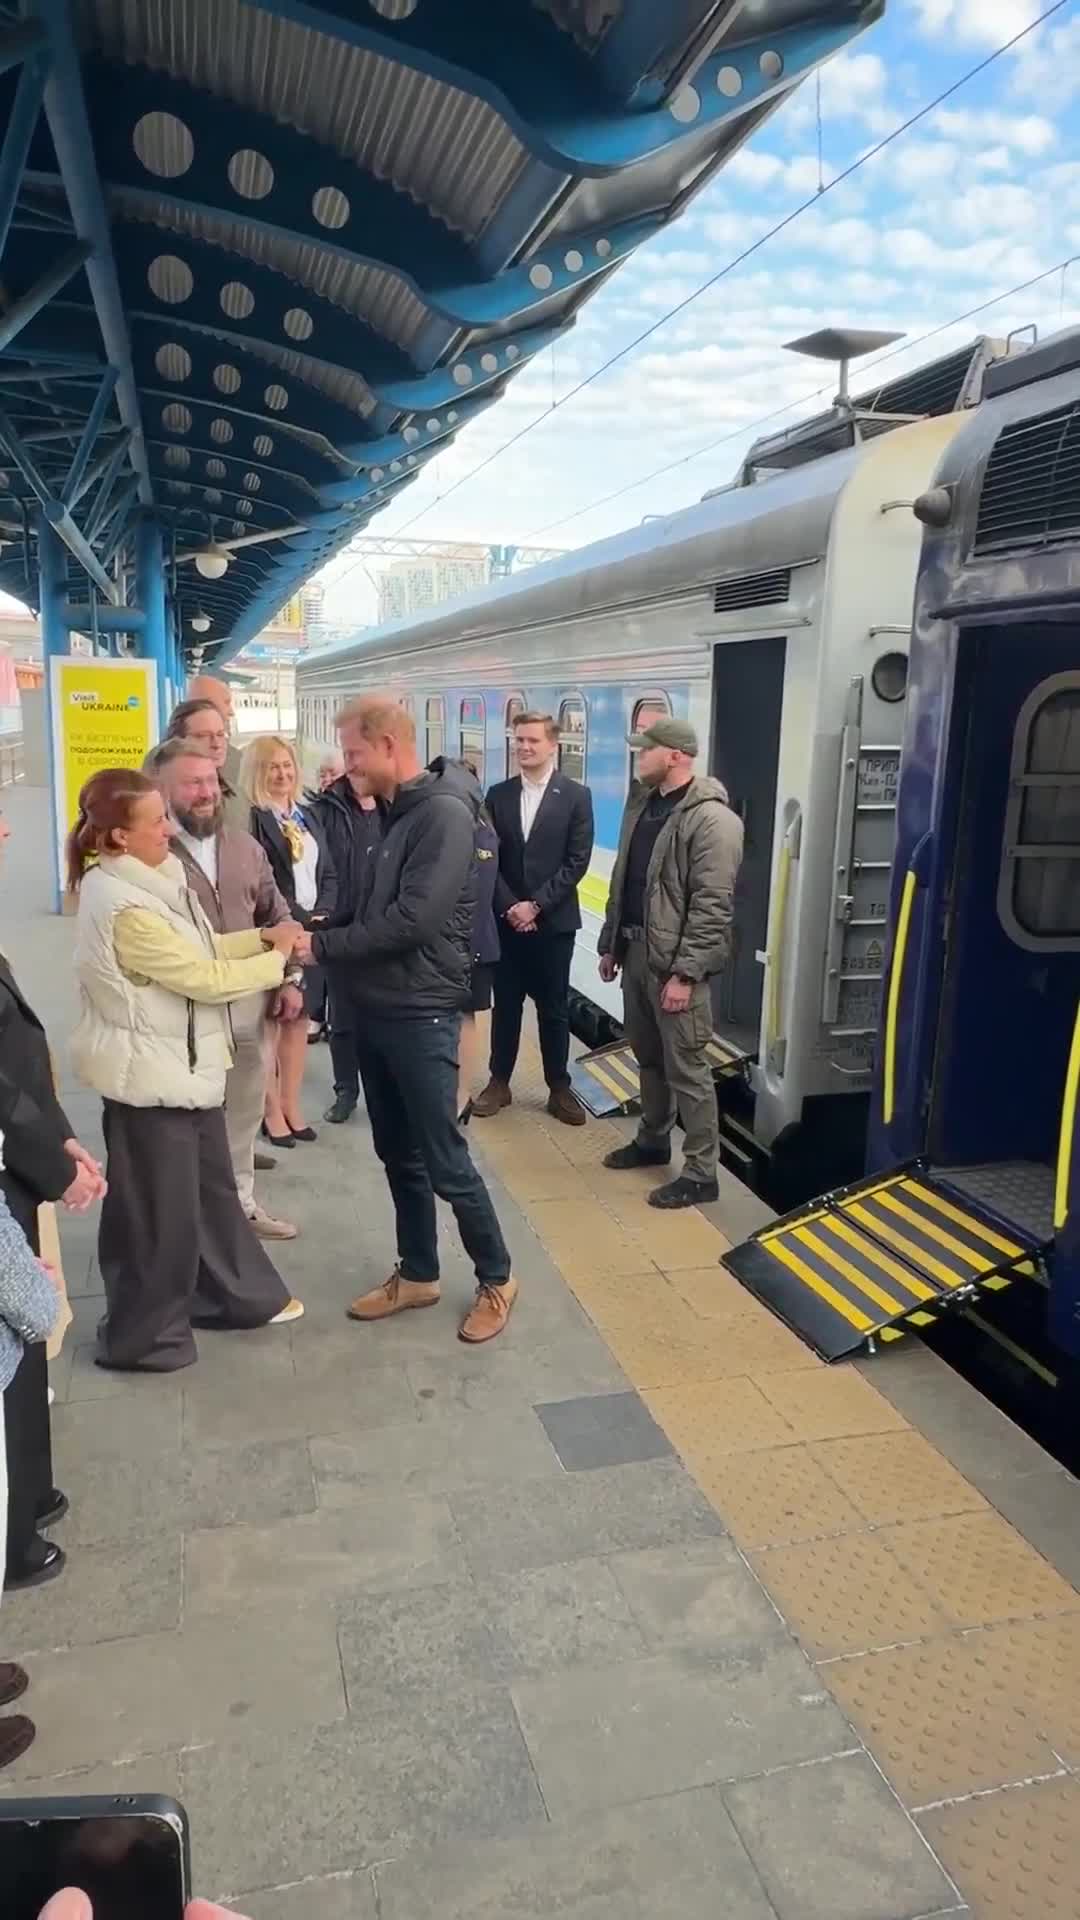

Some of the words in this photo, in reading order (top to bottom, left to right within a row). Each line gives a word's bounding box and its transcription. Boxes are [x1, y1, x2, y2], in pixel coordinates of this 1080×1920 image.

[72, 693, 96, 702] Visit
[81, 703, 129, 712] UKRAINE
[70, 746, 144, 755] ПОДОРОЖУВАТИ
